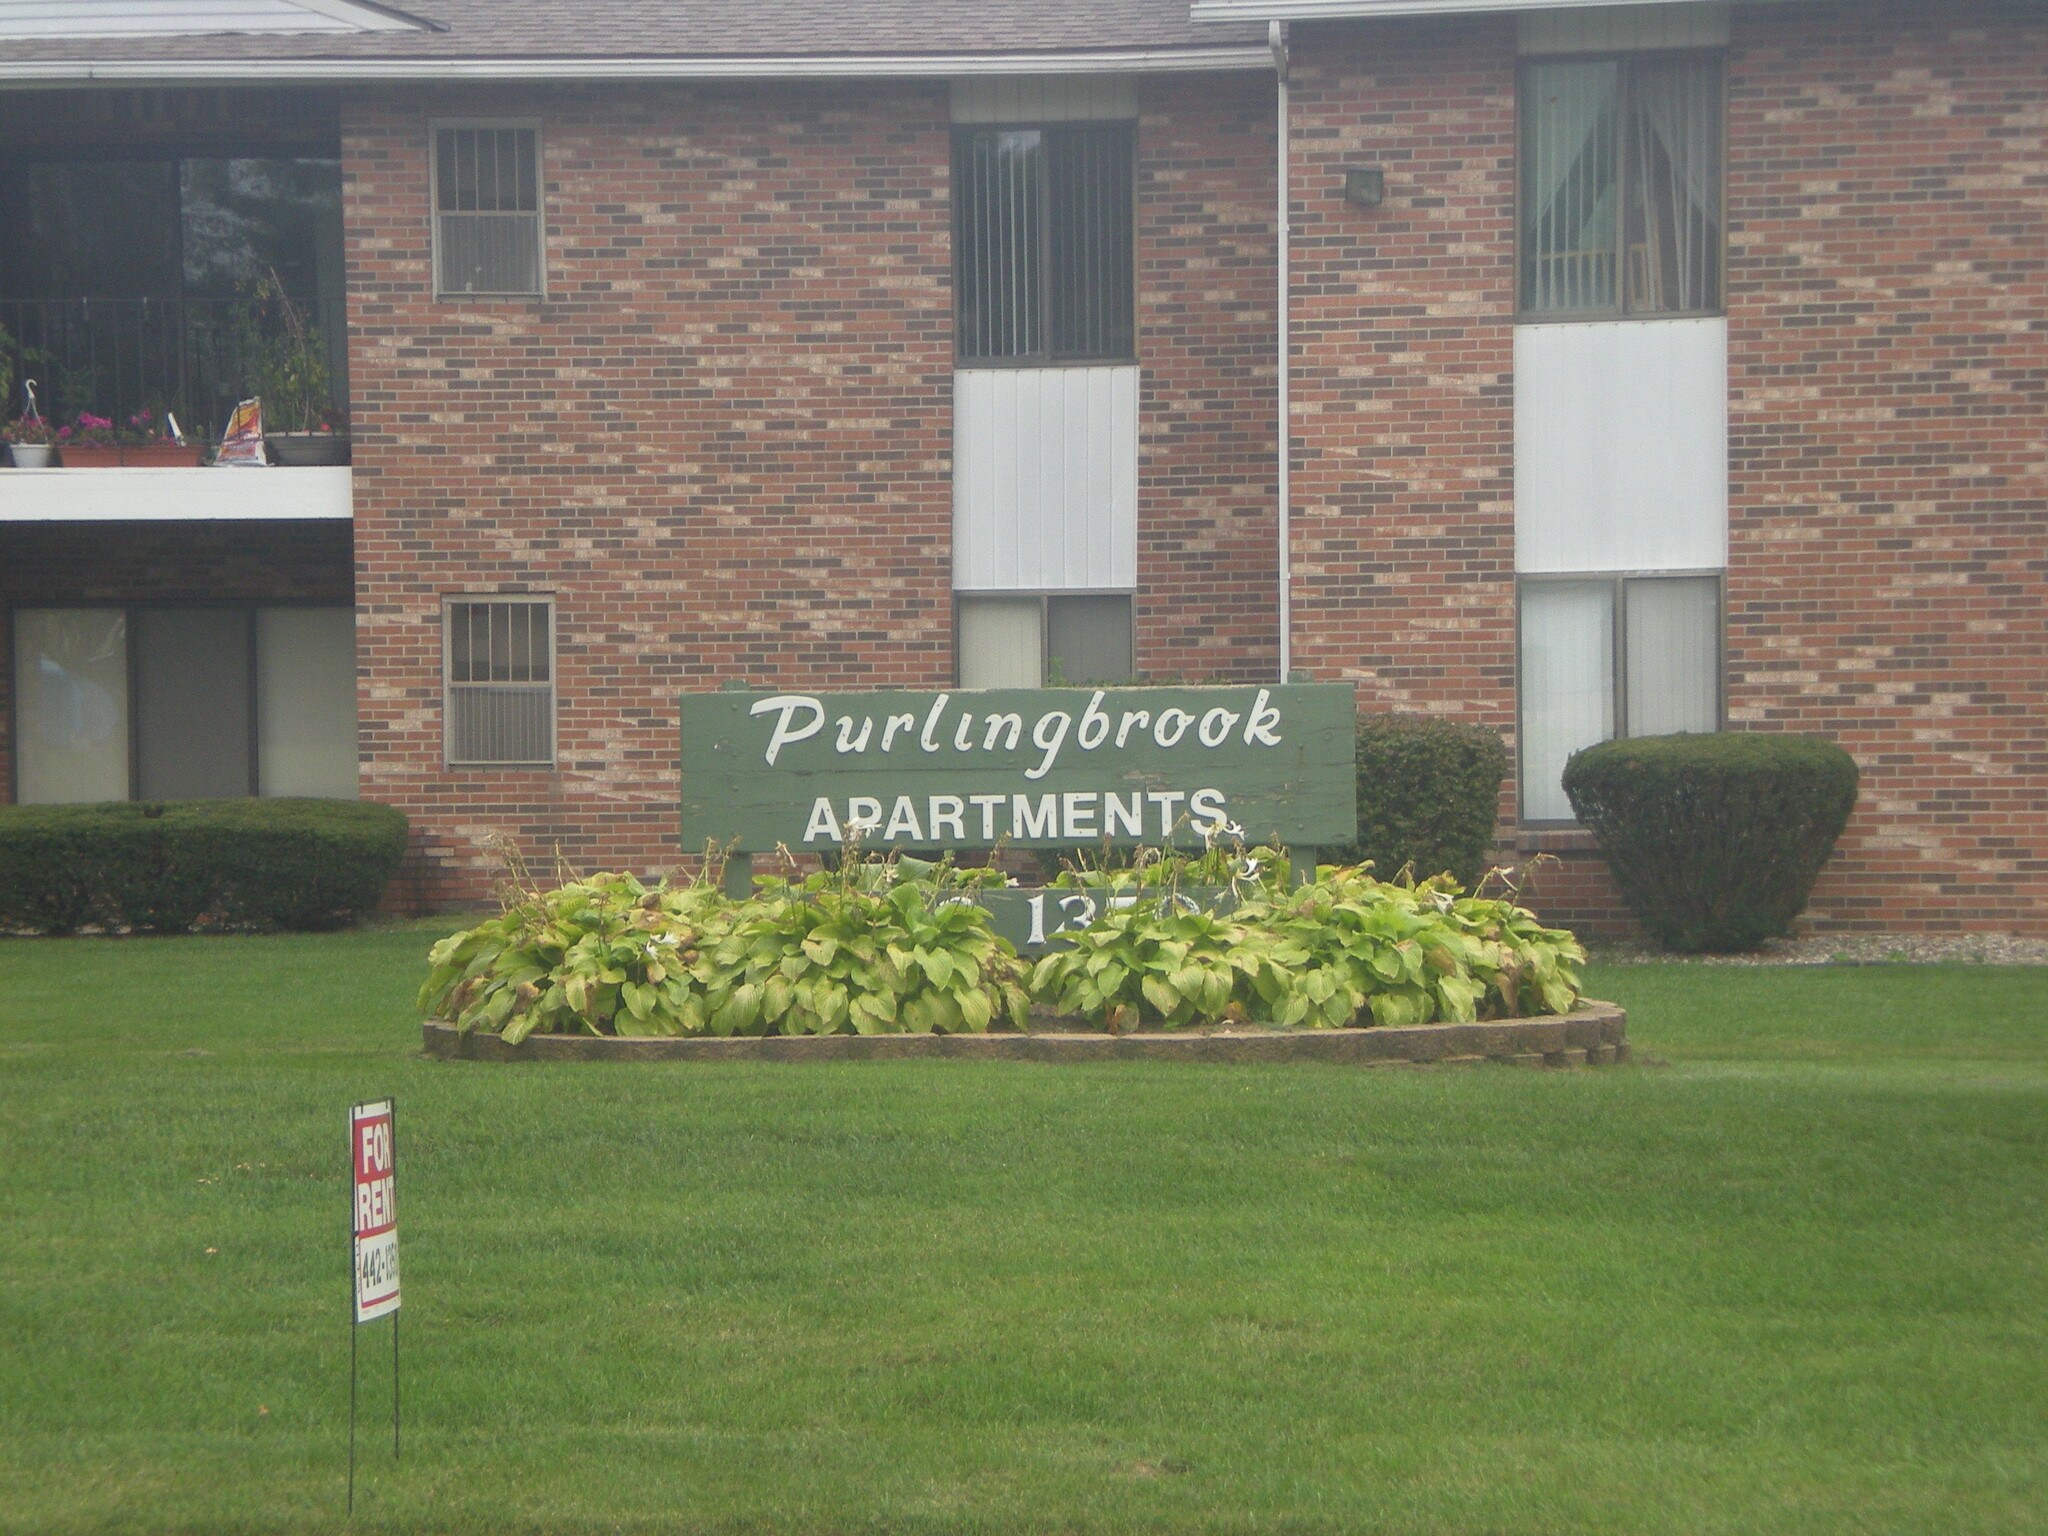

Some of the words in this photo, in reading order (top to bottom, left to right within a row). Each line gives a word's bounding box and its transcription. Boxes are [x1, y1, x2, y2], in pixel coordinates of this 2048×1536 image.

[749, 688, 1283, 780] Purlingbrook
[803, 788, 1228, 842] APARTMENTS
[362, 1122, 391, 1175] FOR
[357, 1175, 395, 1232] RENT
